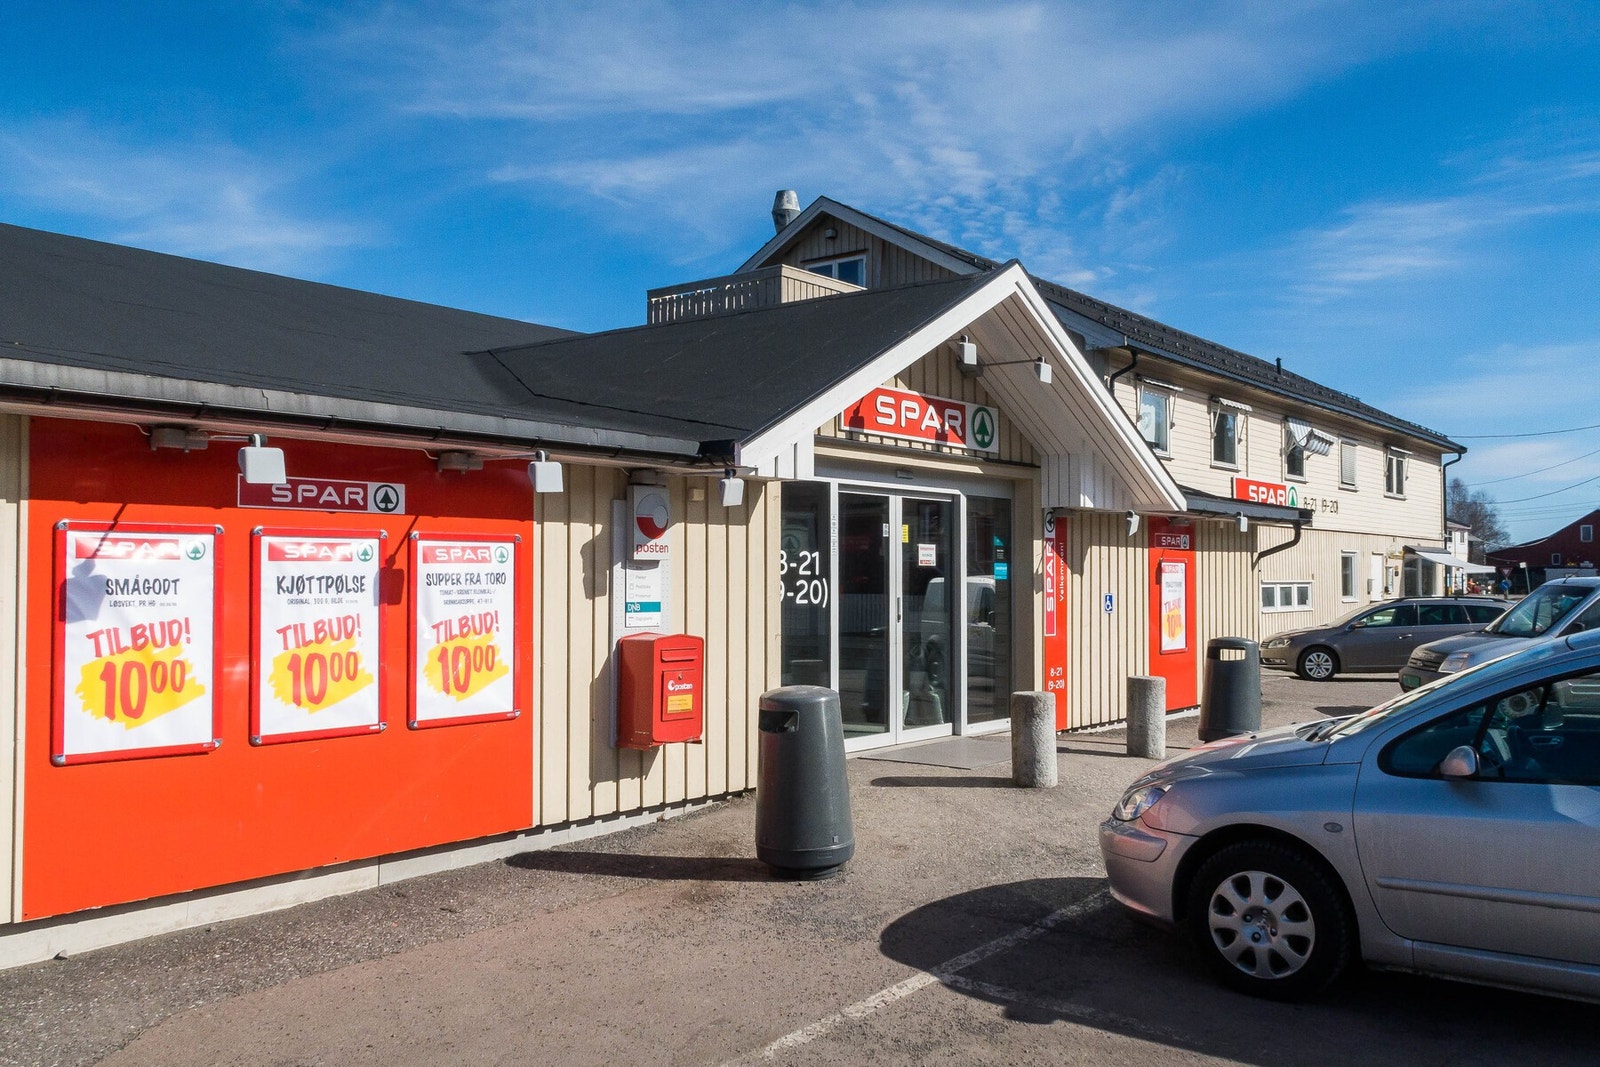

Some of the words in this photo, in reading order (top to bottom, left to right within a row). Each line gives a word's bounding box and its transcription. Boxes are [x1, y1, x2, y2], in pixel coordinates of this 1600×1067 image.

[875, 395, 963, 437] SPAR
[272, 483, 365, 506] SPAR
[1248, 485, 1286, 506] SPAR
[285, 544, 352, 558] SPAR
[636, 542, 669, 555] posten
[1161, 535, 1181, 546] SPAR
[435, 548, 491, 561] SPAR
[105, 574, 180, 596] SMÅGODT
[276, 574, 366, 596] KJØTTPØLSE
[426, 572, 462, 586] SUPPER
[465, 572, 482, 586] FRA
[485, 572, 506, 585] TORO
[1046, 541, 1054, 612] SPAR
[627, 601, 641, 612] DNB
[86, 617, 191, 657] TILBUD!
[276, 613, 361, 650] TILBUD!
[431, 610, 499, 644] TILBUD!
[1050, 666, 1063, 677] 8-21
[1048, 679, 1065, 691] (9-20)
